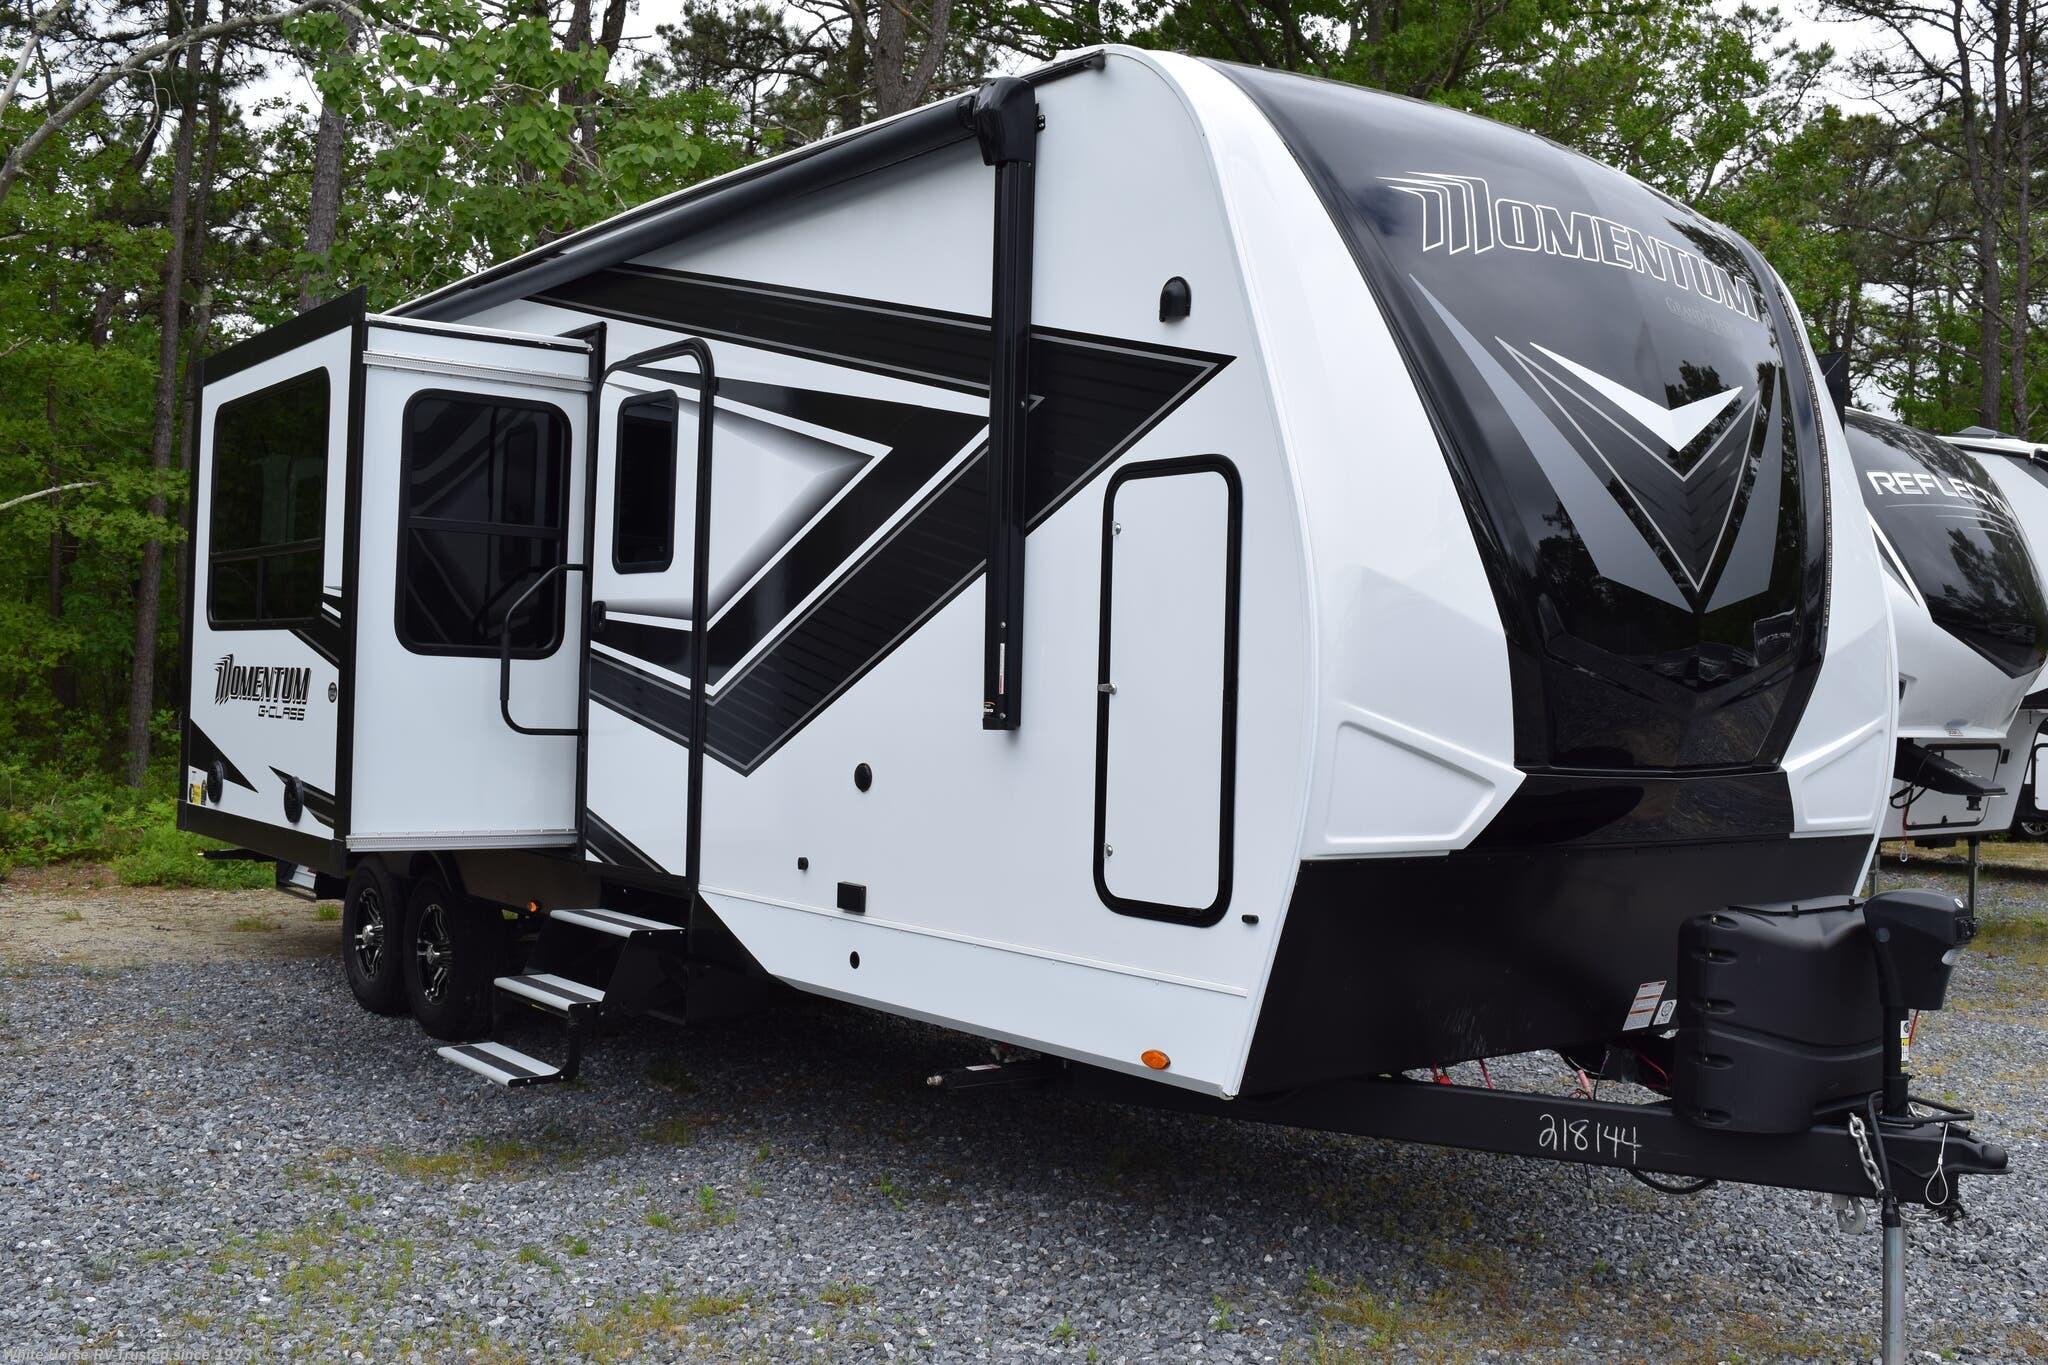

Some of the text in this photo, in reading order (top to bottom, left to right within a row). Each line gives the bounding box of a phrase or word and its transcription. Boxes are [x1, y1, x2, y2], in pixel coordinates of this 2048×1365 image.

[1375, 171, 1759, 322] MOMENTUM
[213, 653, 312, 705] MOMENTUM
[258, 705, 306, 721] G-CLASS
[1539, 1113, 1643, 1165] 218144
